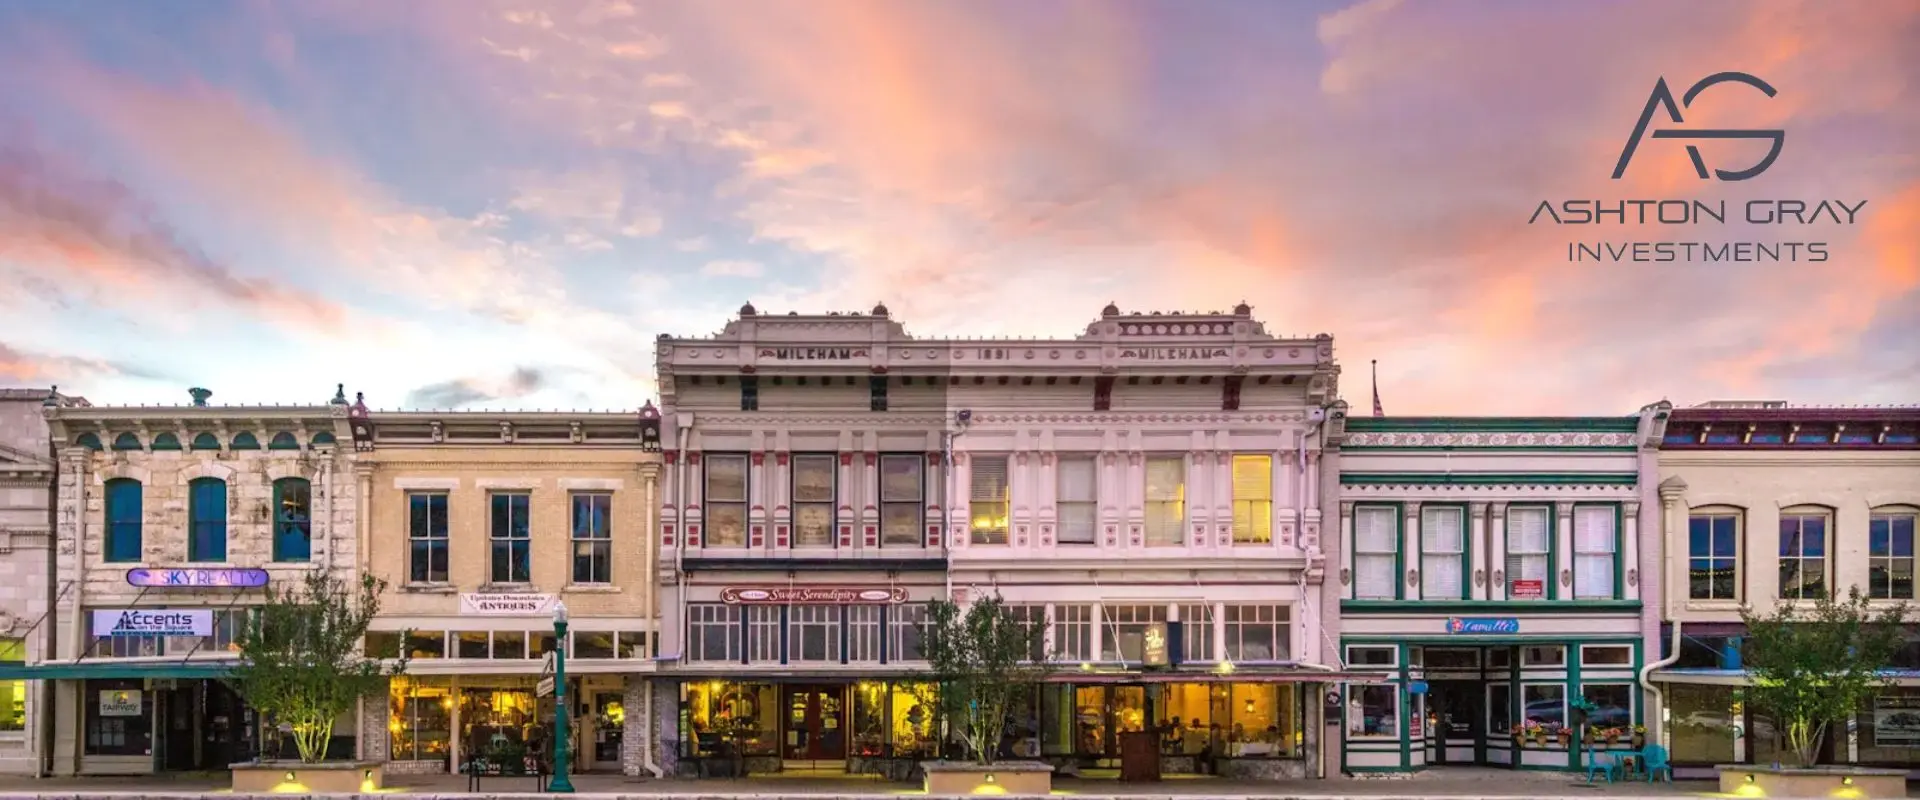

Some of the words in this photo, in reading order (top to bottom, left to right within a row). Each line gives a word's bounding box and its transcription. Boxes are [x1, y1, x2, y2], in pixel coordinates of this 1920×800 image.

[776, 349, 850, 360] MILEHAM
[1138, 349, 1212, 360] MILEHAM
[161, 570, 194, 585] SKY
[197, 570, 259, 585] REALTY
[768, 588, 801, 601] Sweet
[801, 588, 857, 602] Serendipity
